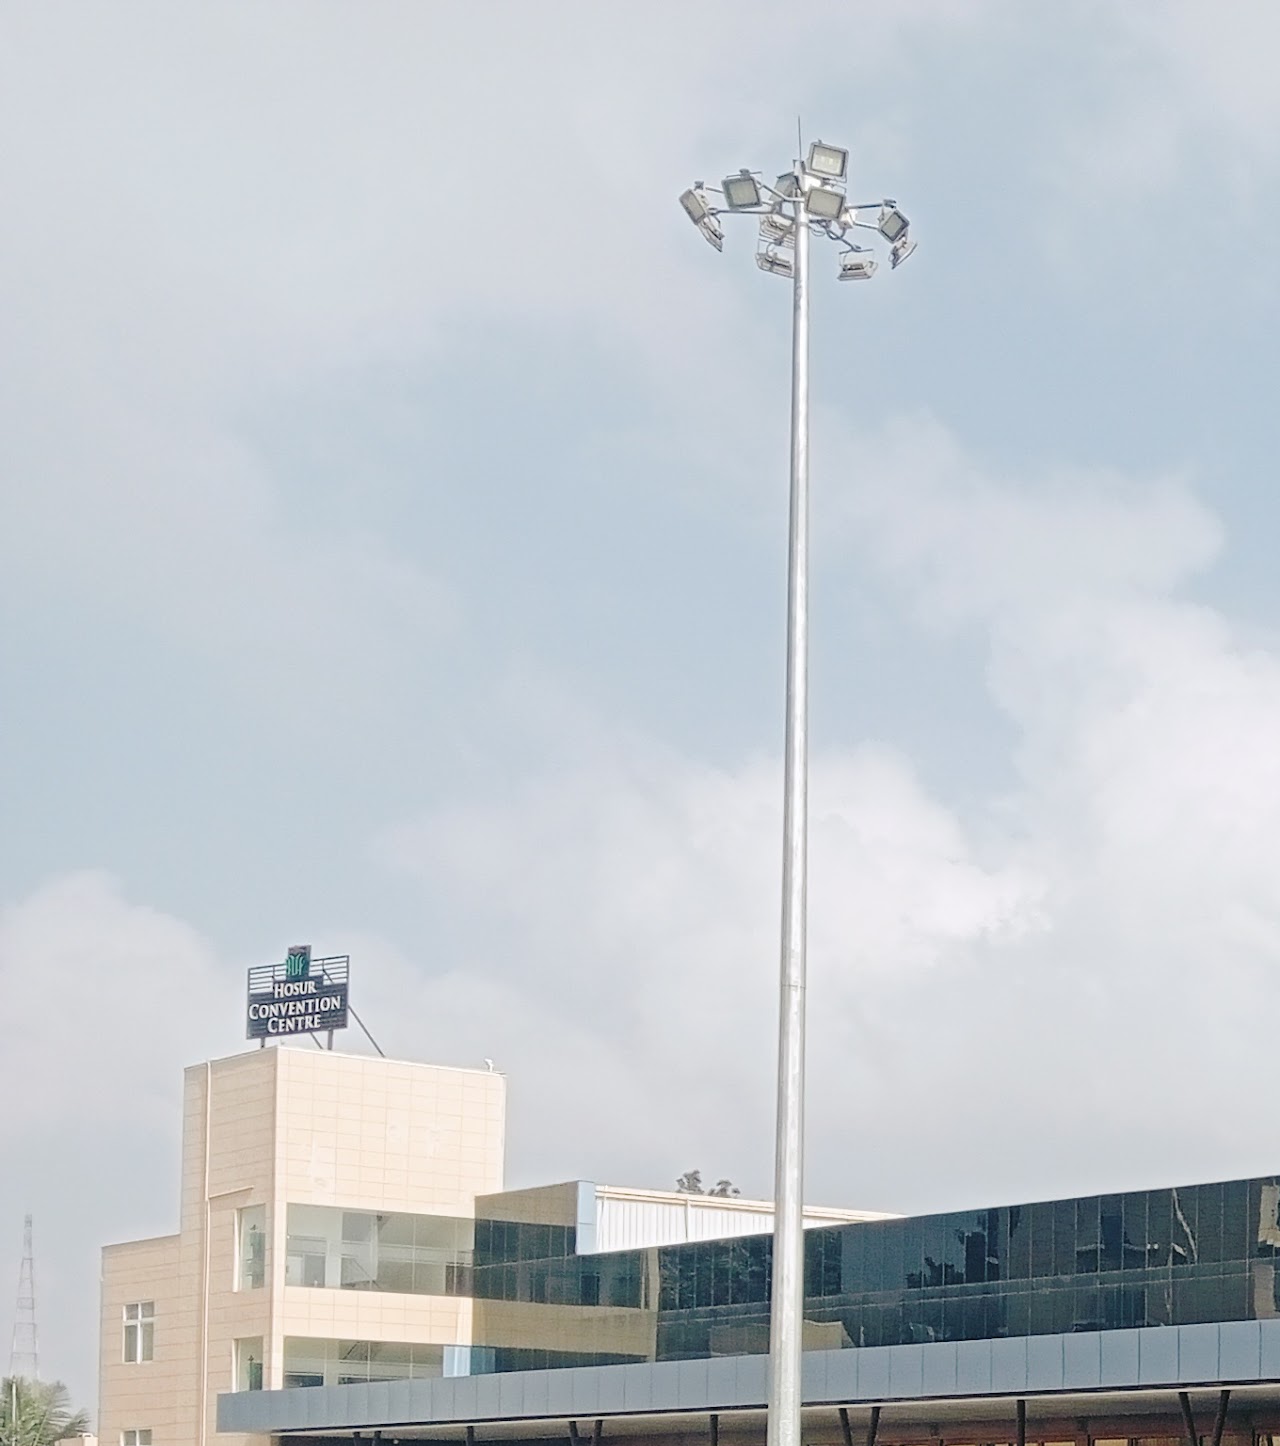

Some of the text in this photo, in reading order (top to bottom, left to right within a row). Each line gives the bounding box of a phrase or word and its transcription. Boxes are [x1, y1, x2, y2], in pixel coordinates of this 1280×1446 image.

[274, 981, 318, 999] HOSUR
[248, 996, 341, 1020] CONVENTION
[267, 1014, 321, 1033] CENTRE
